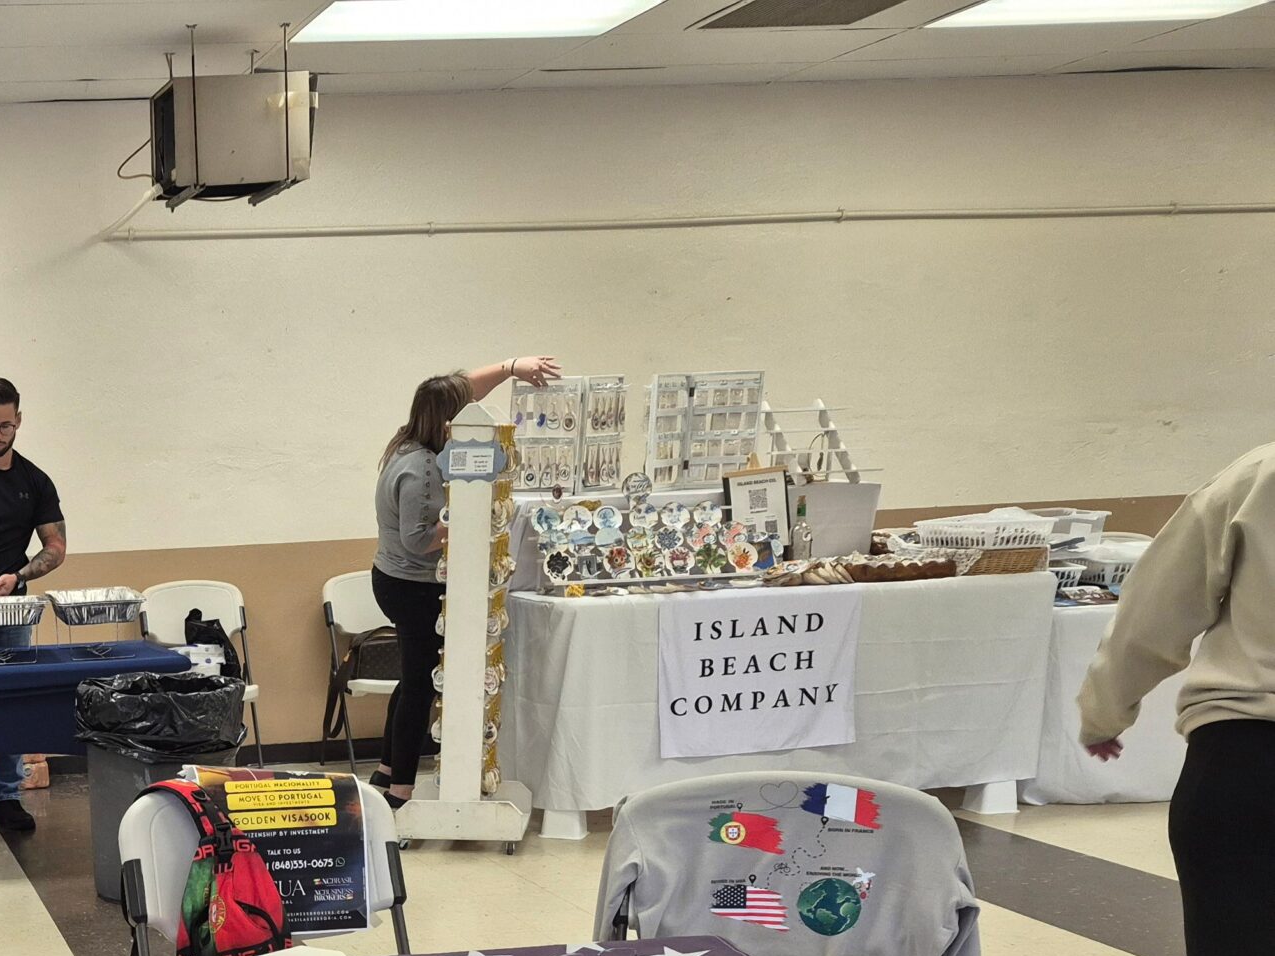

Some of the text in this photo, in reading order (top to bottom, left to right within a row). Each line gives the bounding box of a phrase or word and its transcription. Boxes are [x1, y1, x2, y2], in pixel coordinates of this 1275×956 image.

[693, 612, 824, 641] ISLAND
[699, 650, 815, 678] BEACH
[670, 683, 839, 716] COMPANY
[278, 792, 323, 800] PORTUGAL
[233, 812, 331, 826] GOLDEN VISA500K
[290, 828, 329, 836] INVESTMENT
[271, 858, 334, 871] (848)331-0675
